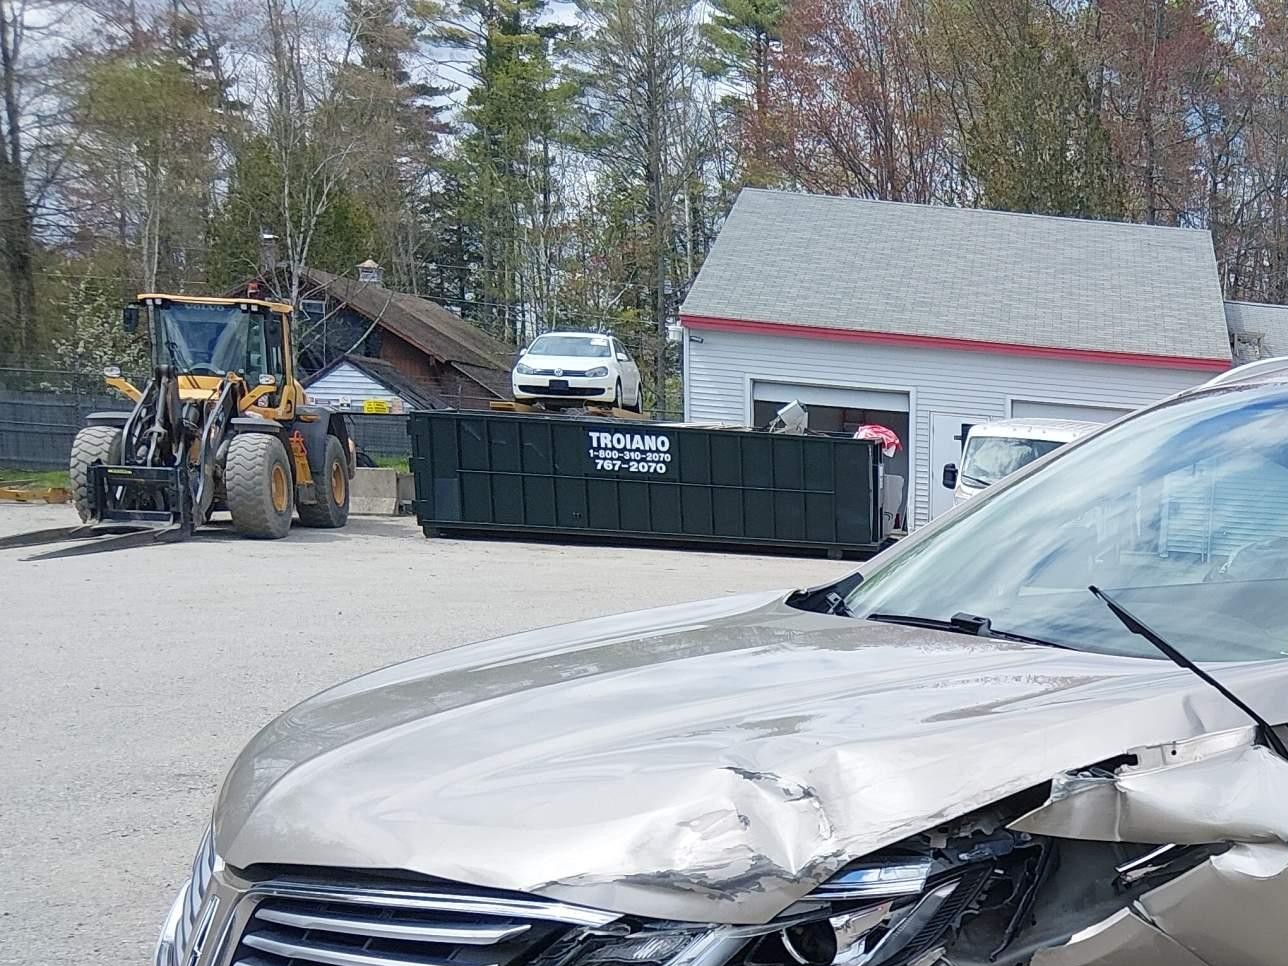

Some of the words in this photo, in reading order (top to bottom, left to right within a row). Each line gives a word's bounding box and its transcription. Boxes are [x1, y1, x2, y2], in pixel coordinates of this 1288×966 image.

[588, 431, 670, 452] TROIANO
[588, 448, 672, 462] 1-800-310-2070
[595, 459, 667, 474] 767-2070
